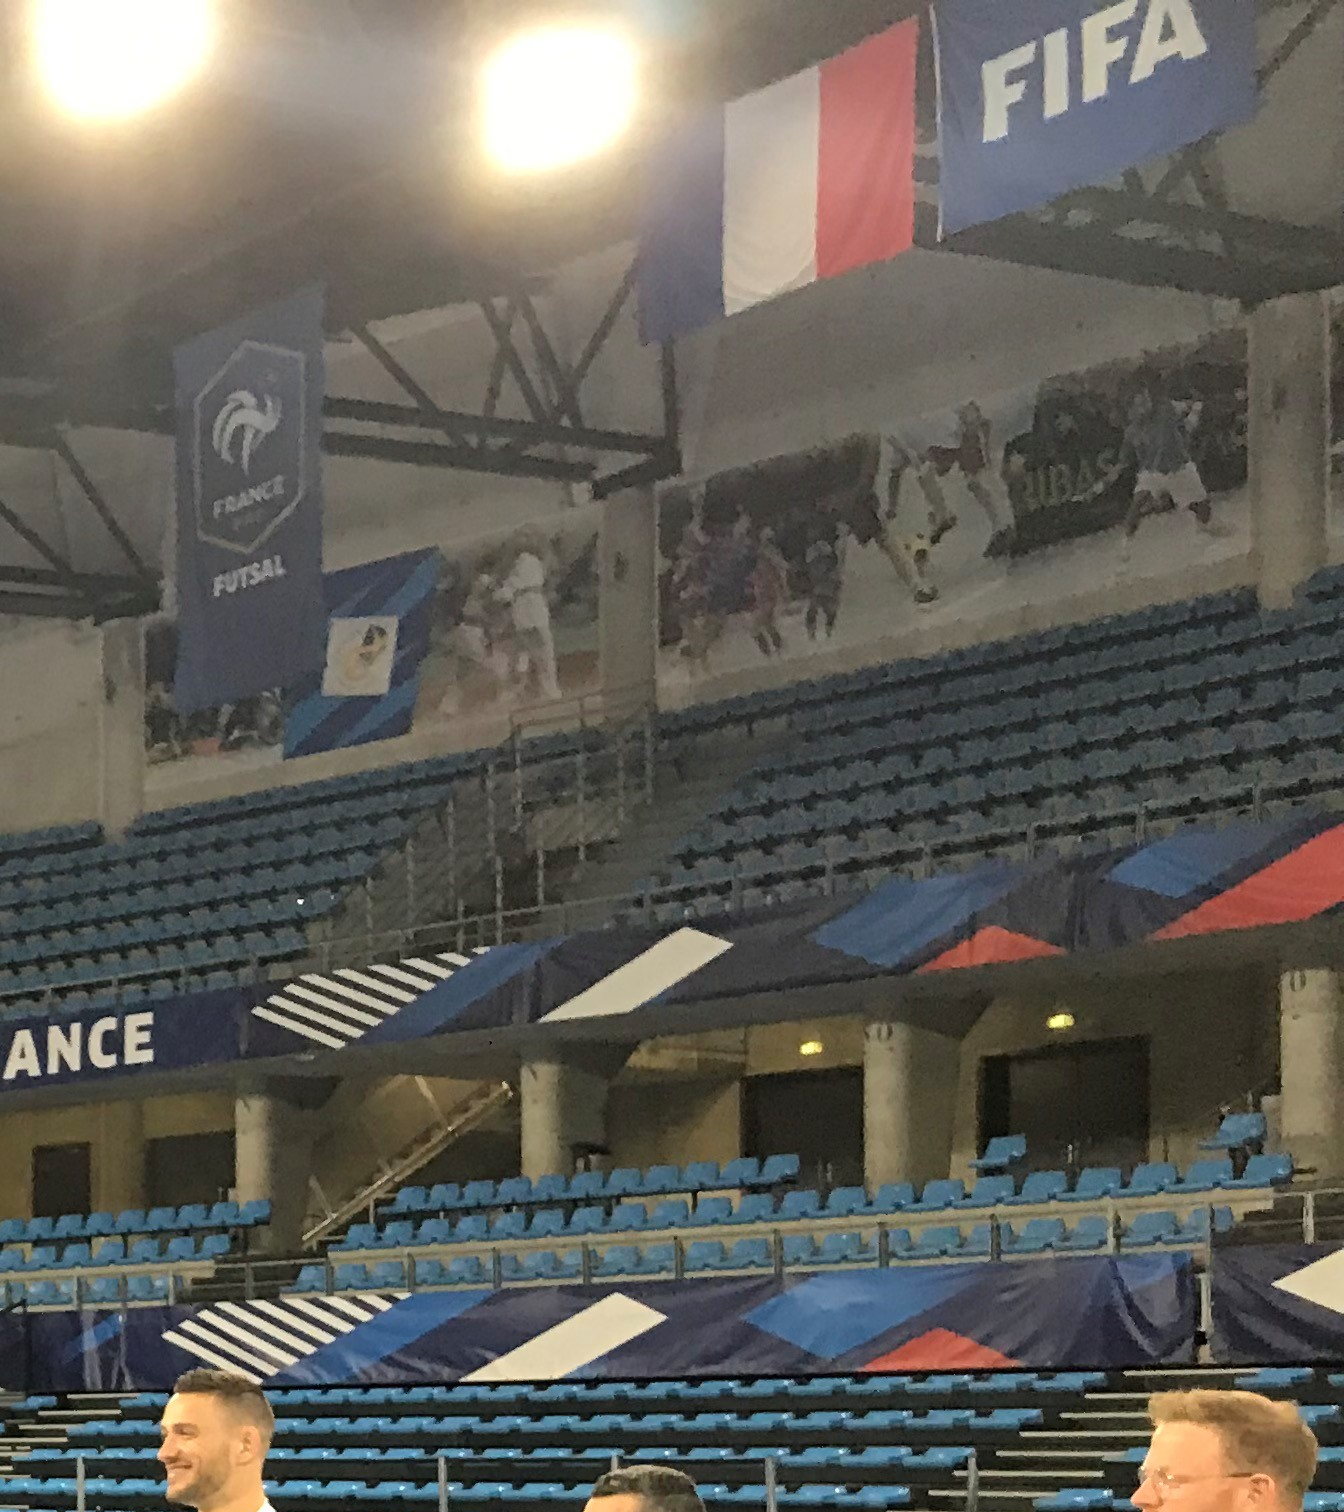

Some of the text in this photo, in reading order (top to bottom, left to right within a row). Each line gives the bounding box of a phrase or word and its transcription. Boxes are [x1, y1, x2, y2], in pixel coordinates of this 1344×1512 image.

[981, 0, 1208, 143] FIFA
[213, 474, 285, 519] FRANCE
[213, 554, 287, 597] FUTSAL
